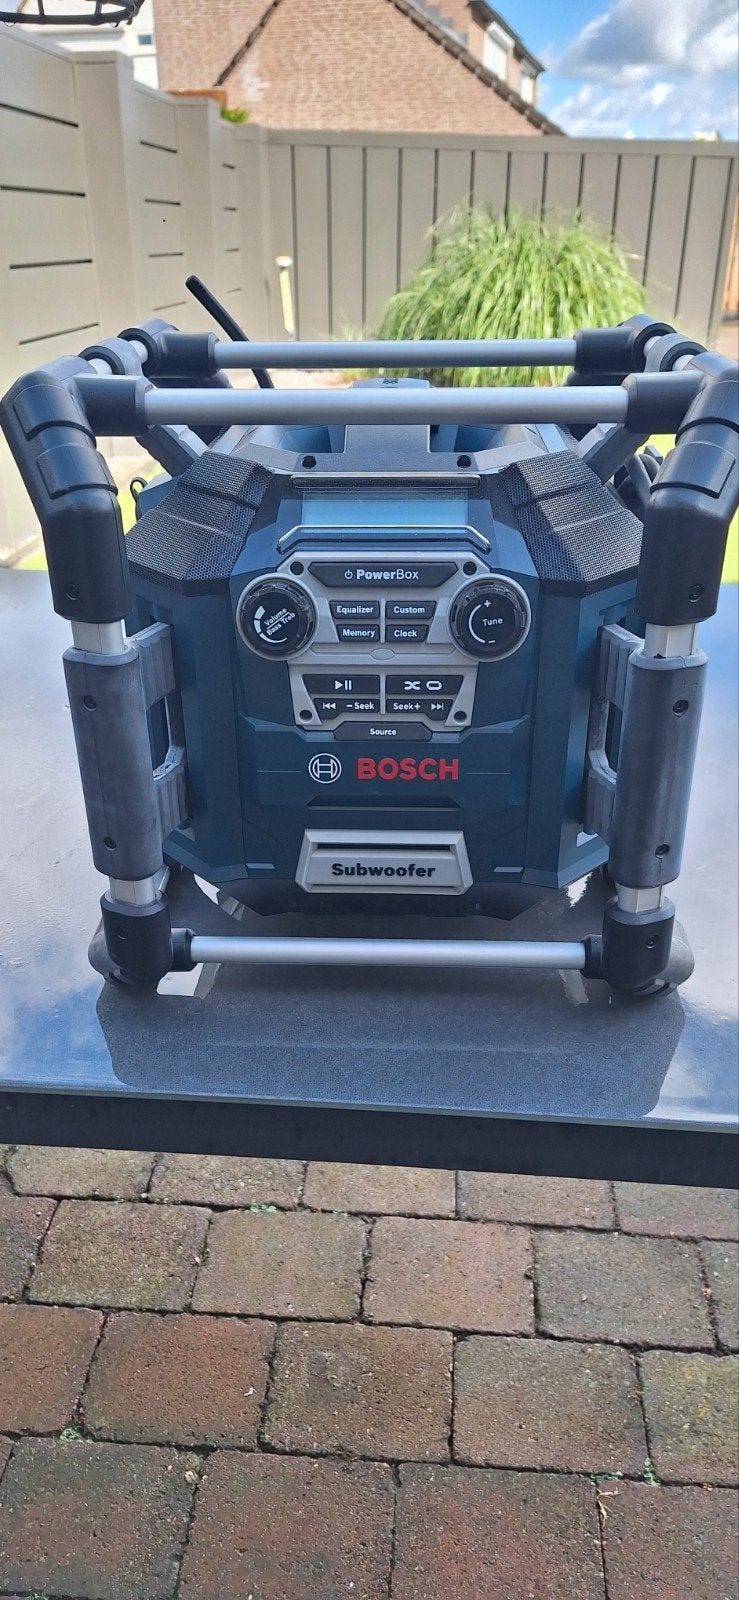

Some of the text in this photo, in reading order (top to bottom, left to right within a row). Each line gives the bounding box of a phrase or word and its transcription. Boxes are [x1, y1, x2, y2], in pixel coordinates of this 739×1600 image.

[356, 568, 419, 580] PowerBox
[336, 605, 374, 615] Equalizer
[393, 605, 425, 614] Custom
[264, 608, 287, 626] Volume
[482, 616, 503, 626] Tune
[266, 612, 296, 636] Bass Treb
[342, 628, 375, 639] Memory
[394, 629, 417, 638] Clock
[369, 728, 397, 736] Source
[357, 758, 459, 780] BOSCH
[331, 862, 436, 877] Subwoofer
